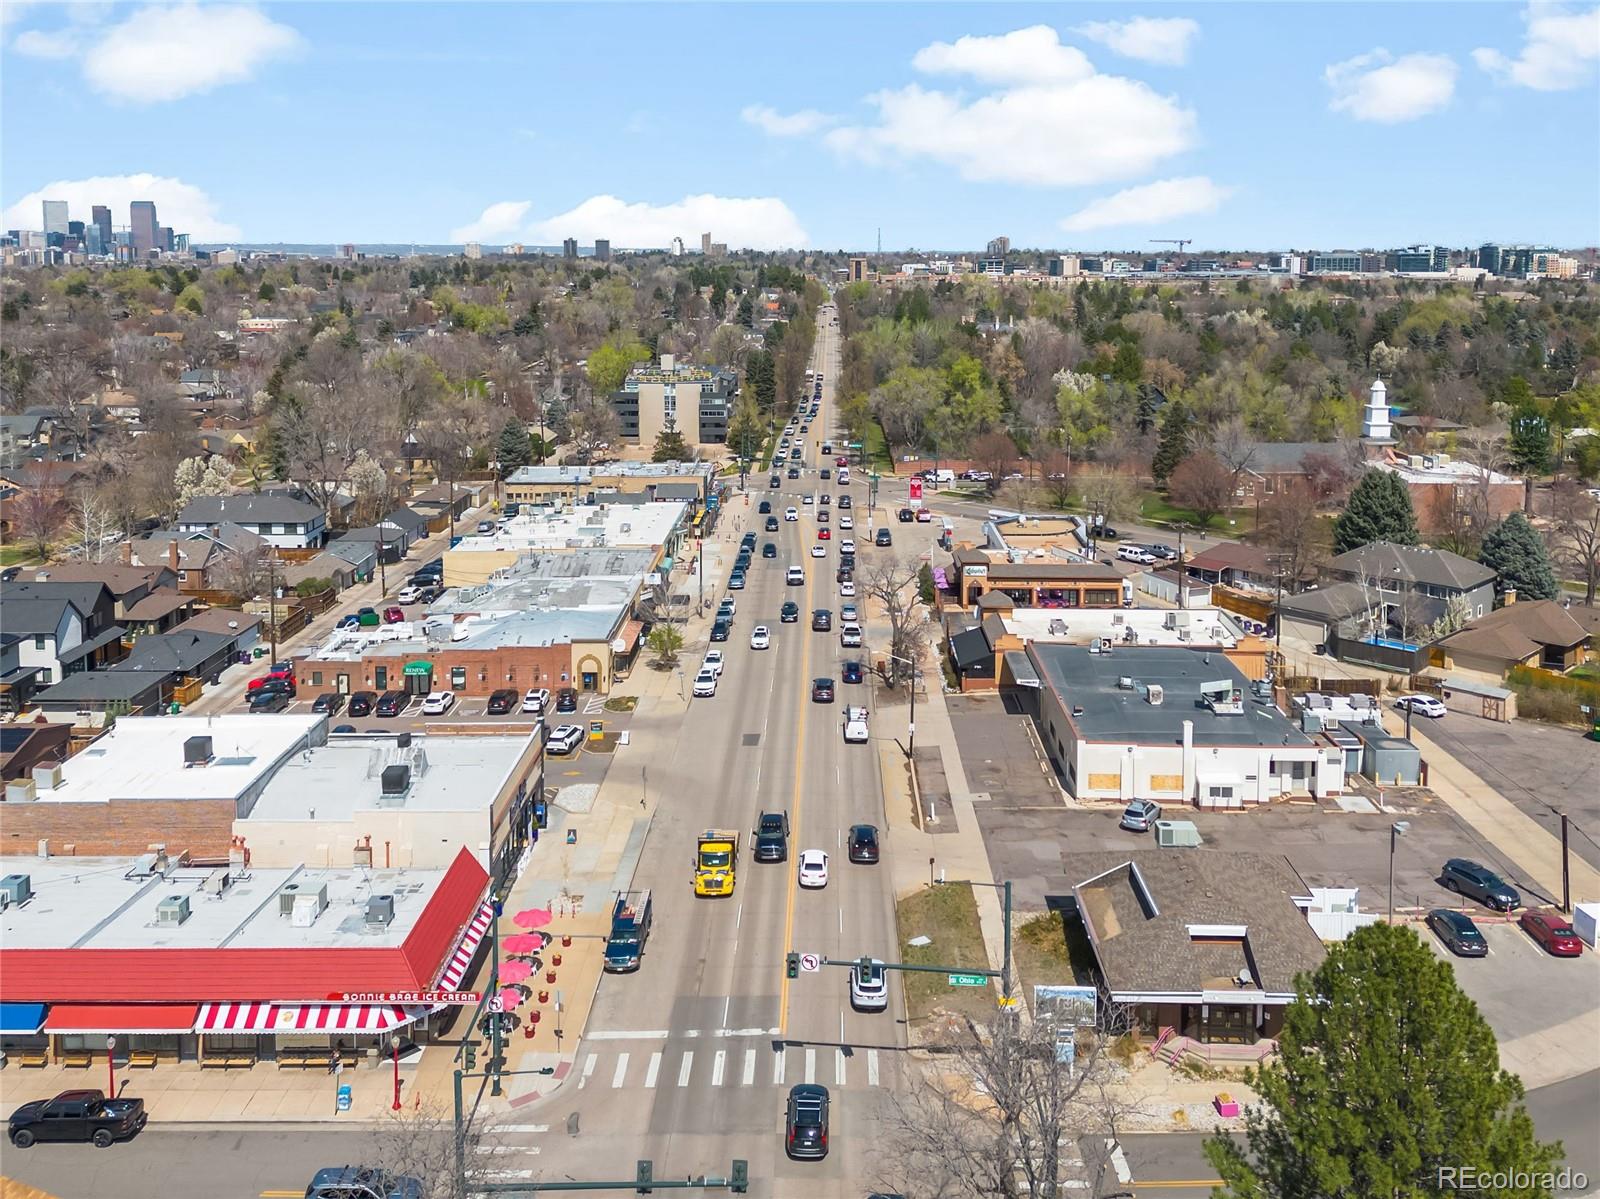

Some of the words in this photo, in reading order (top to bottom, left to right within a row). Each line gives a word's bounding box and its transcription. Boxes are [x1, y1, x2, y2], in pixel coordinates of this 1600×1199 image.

[342, 993, 385, 1001] BONNIE
[389, 993, 419, 1001] BRAE
[422, 993, 439, 1001] ICE
[441, 993, 476, 1001] CREAM
